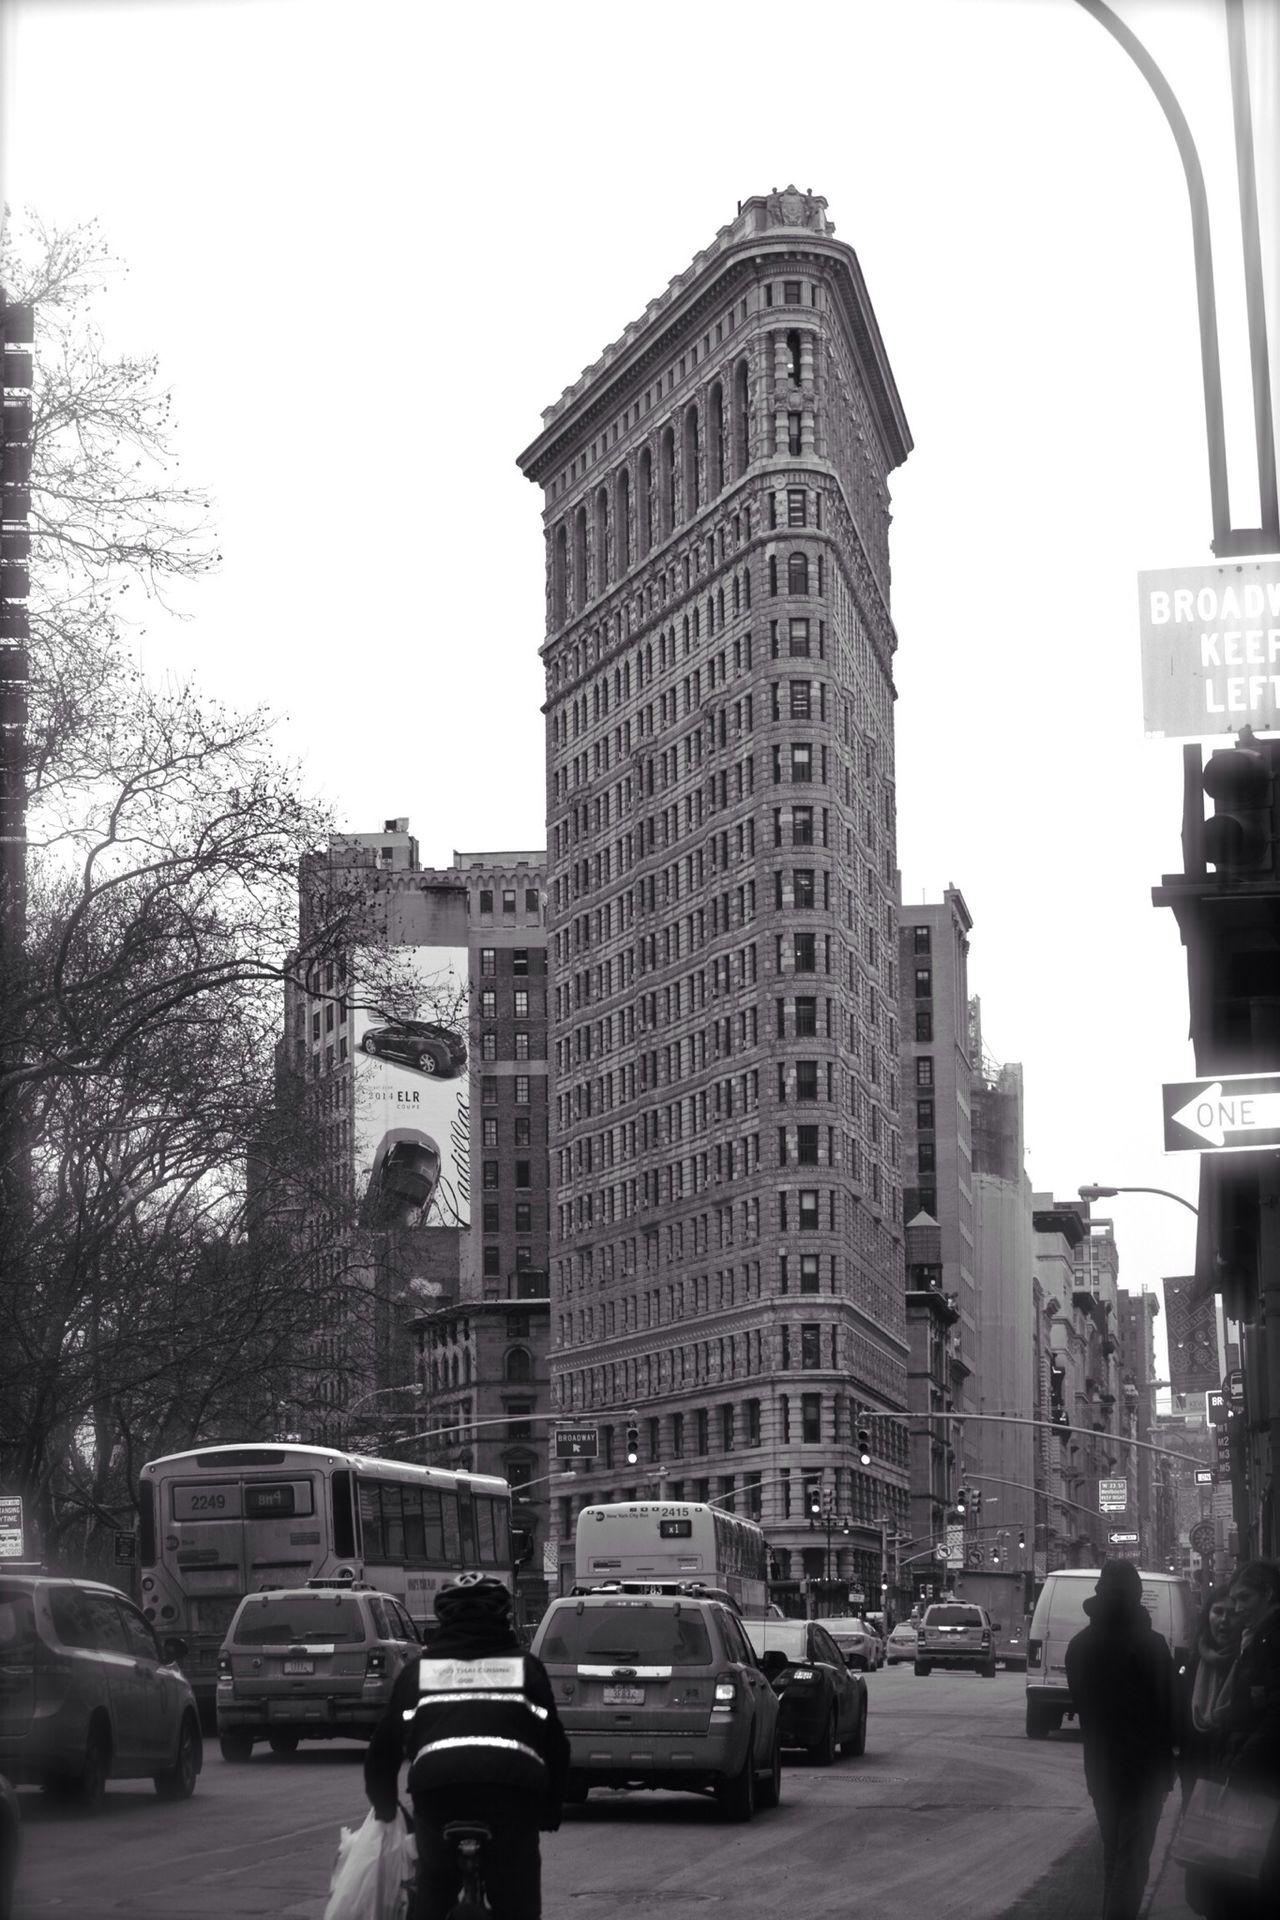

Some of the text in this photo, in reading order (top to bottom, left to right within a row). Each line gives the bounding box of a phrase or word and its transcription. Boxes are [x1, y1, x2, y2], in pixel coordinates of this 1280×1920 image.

[397, 1090, 420, 1103] ELR
[1196, 1099, 1256, 1128] ONE
[431, 1092, 470, 1227] Cadillac
[1212, 1396, 1224, 1406] BR
[1217, 1423, 1228, 1432] M1
[558, 1433, 596, 1442] BROADWAY
[1218, 1436, 1230, 1446] M2
[1219, 1449, 1230, 1459] M3
[1220, 1462, 1231, 1472] M5
[191, 1494, 226, 1510] 2249
[662, 1508, 690, 1517] 2415
[669, 1524, 679, 1534] x1
